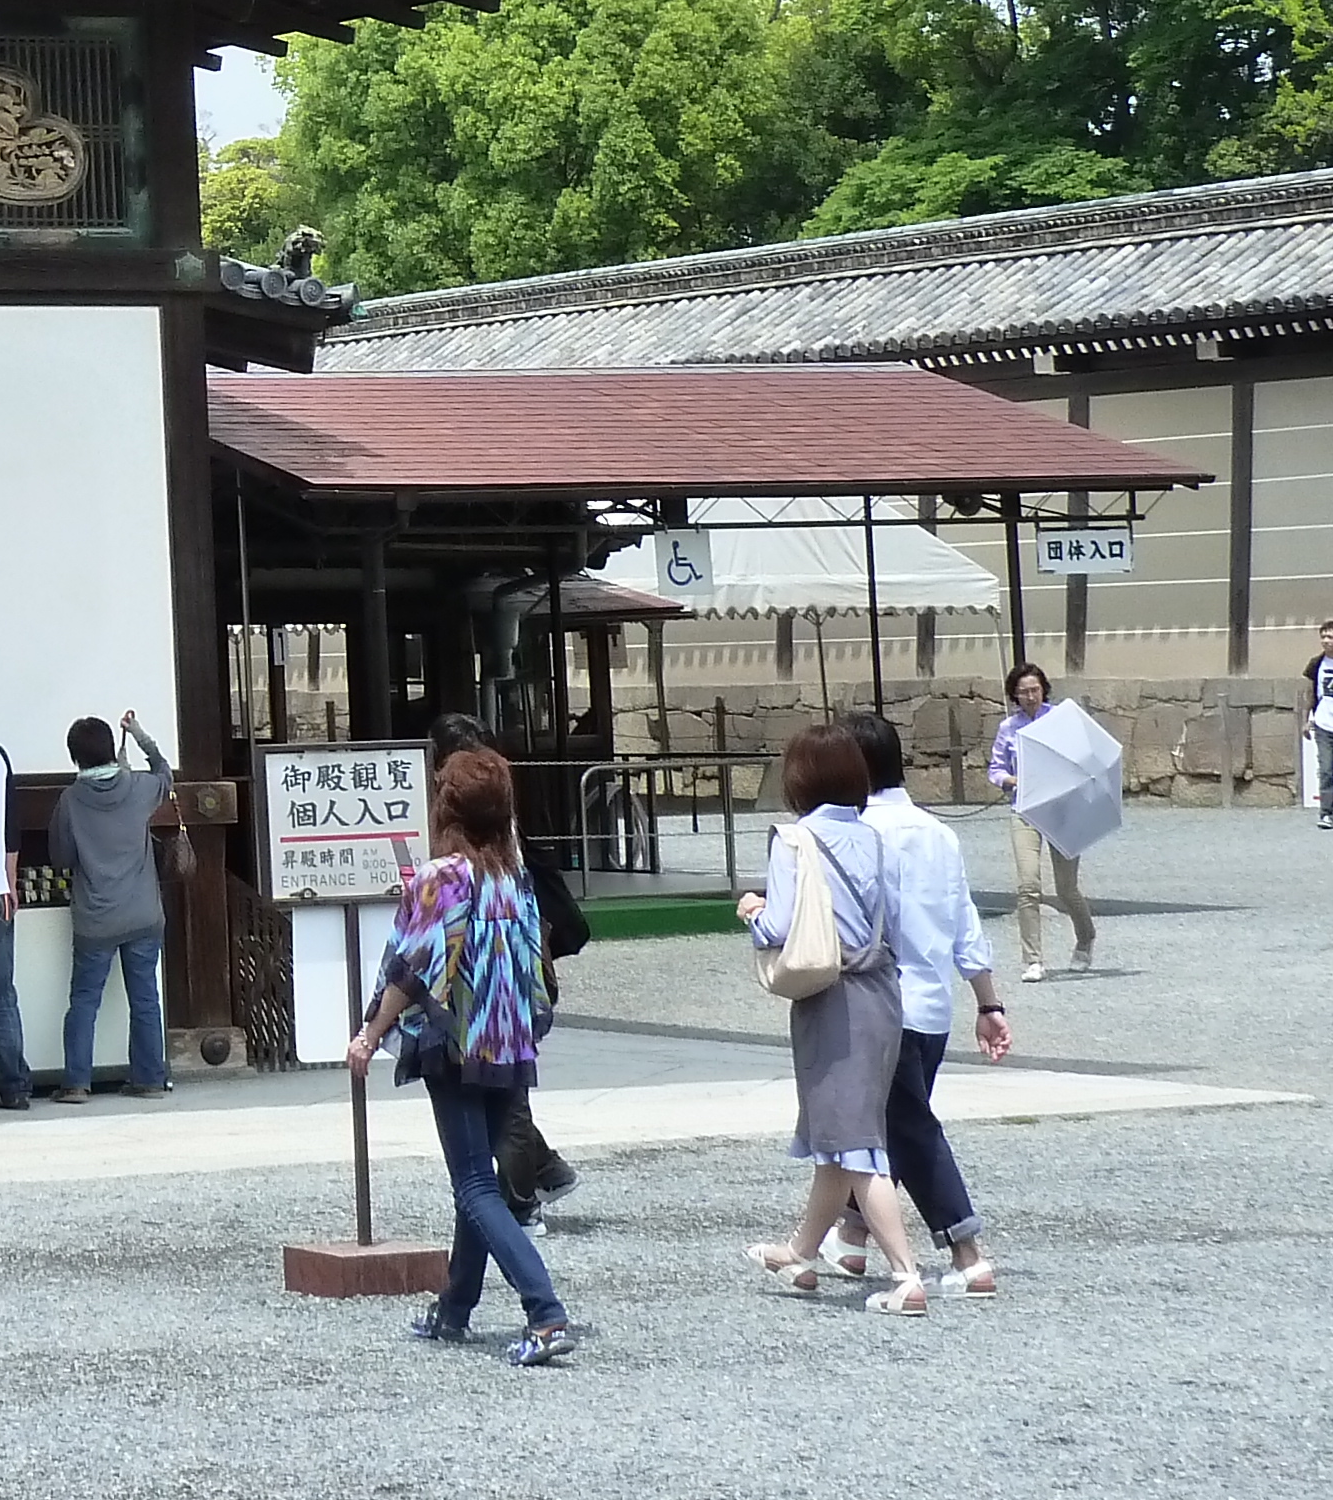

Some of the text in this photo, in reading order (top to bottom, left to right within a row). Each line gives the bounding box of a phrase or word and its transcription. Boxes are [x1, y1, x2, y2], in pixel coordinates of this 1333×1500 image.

[1046, 540, 1125, 561] 団体入口
[281, 760, 414, 794] 御殿観覧
[287, 798, 410, 829] 個人入口
[281, 871, 401, 888] ENTRANCE HOU
